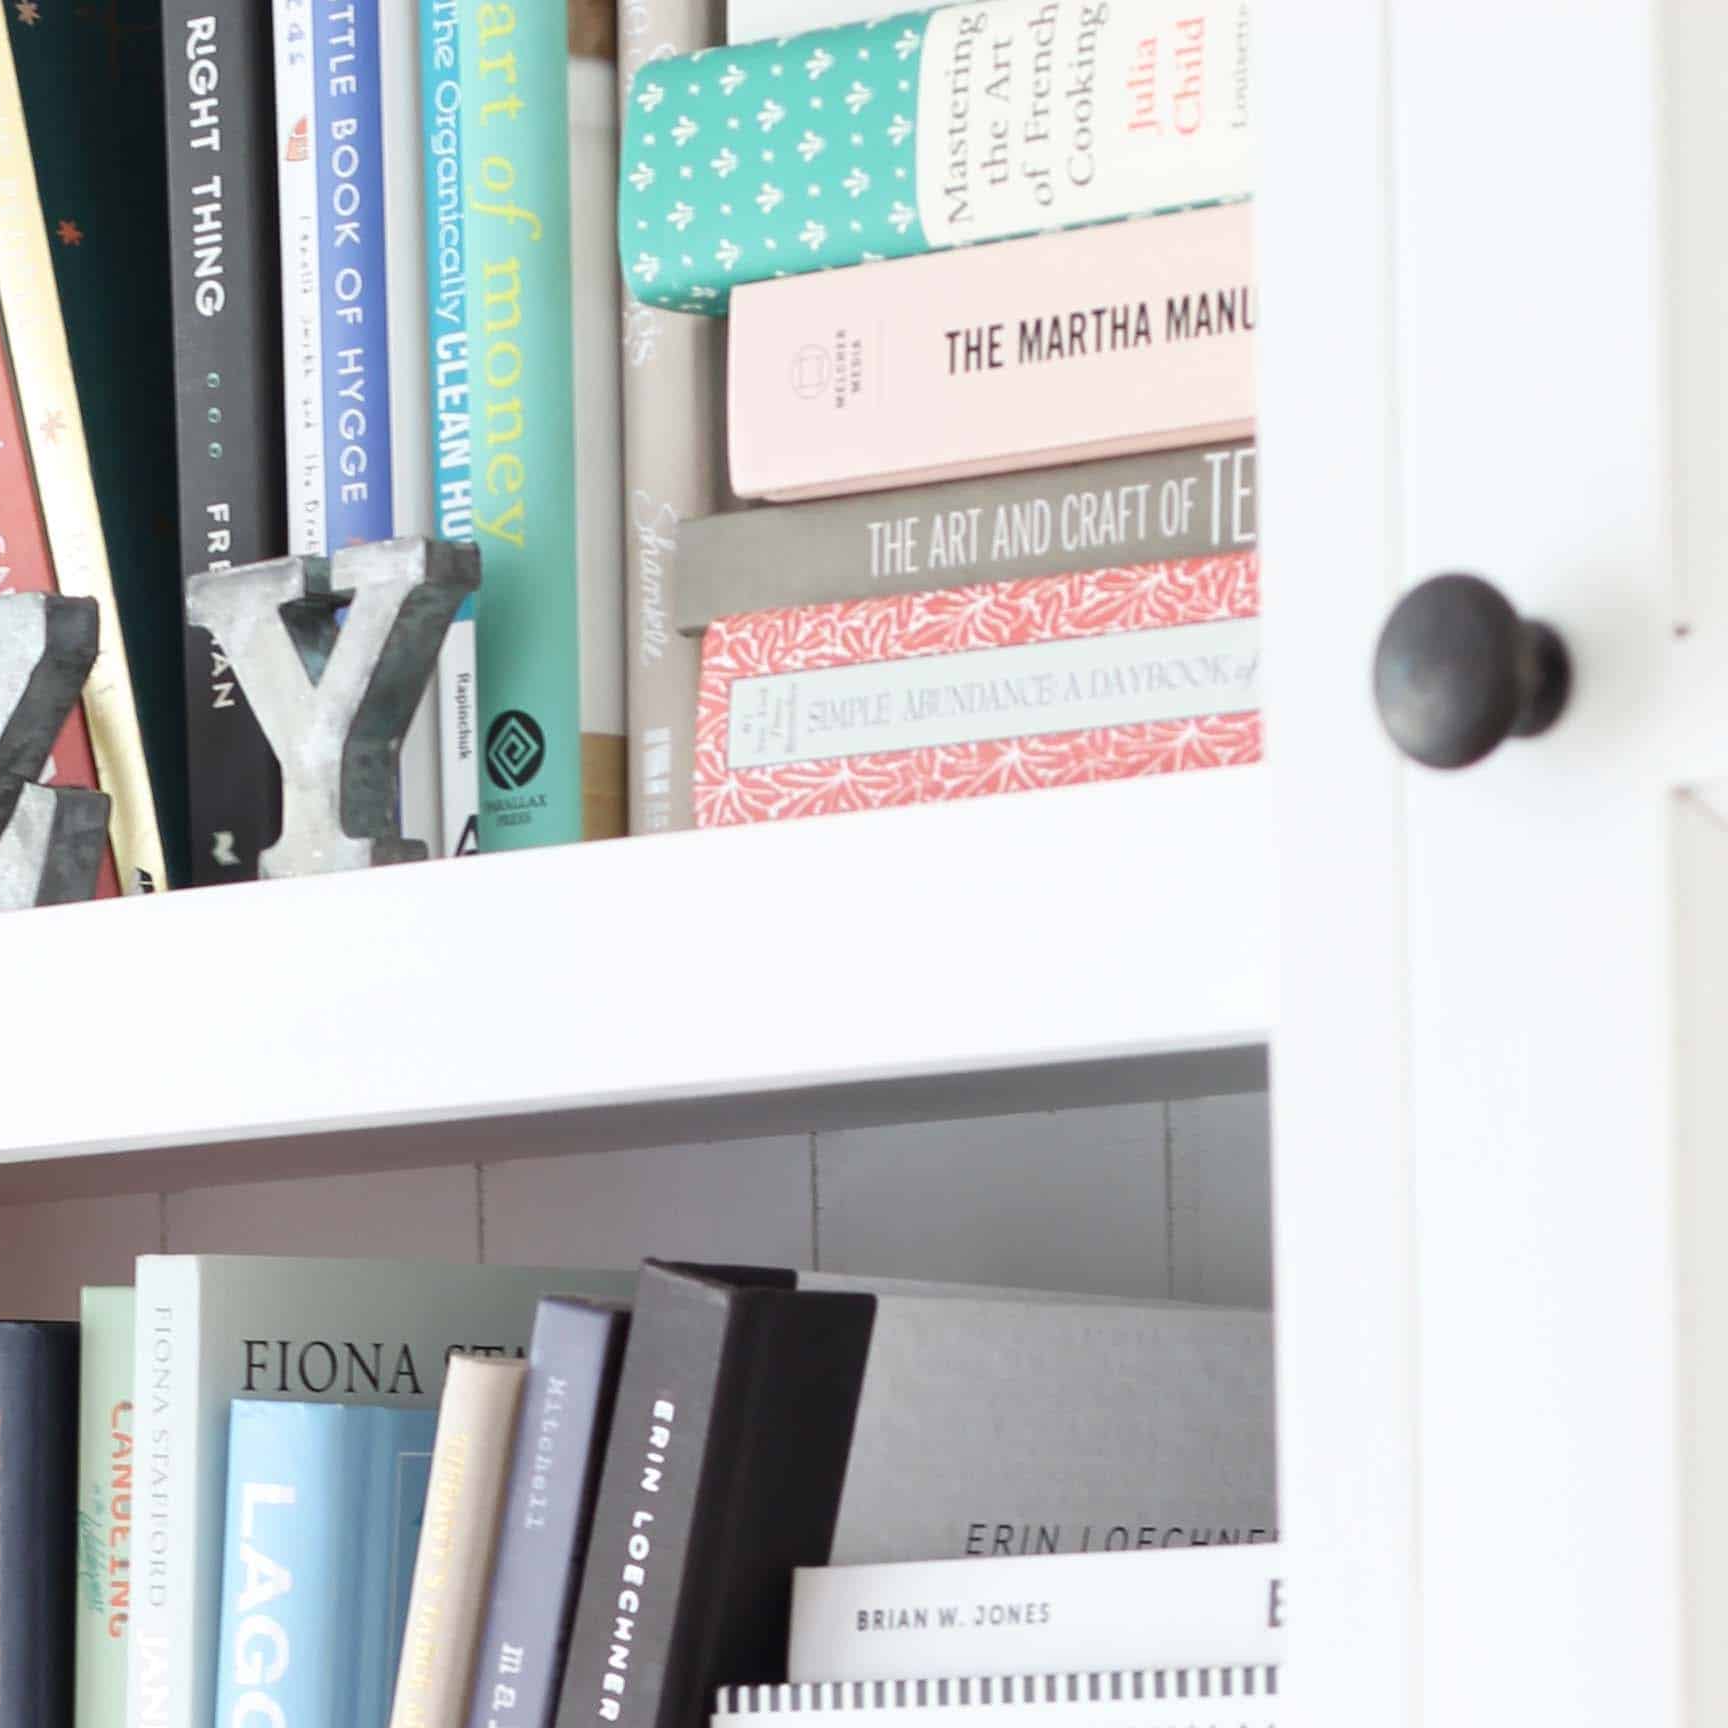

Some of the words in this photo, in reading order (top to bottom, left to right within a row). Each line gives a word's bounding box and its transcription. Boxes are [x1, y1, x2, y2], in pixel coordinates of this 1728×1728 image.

[186, 16, 220, 151] RIGHT
[477, 3, 525, 125] art
[948, 8, 988, 224] Mastering
[985, 34, 1014, 102] Art
[1023, 2, 1060, 146] French
[1067, 0, 1109, 187] Cooking
[1127, 35, 1164, 136] Julia
[1175, 16, 1204, 137] Child
[331, 118, 361, 248] BOOK
[431, 80, 469, 323] Organically
[465, 155, 542, 243] of
[982, 115, 1009, 187] the
[1023, 157, 1051, 207] of
[192, 176, 225, 316] THING
[335, 268, 363, 327] OF
[945, 323, 1005, 376] THE
[1018, 301, 1151, 364] MARTHA
[337, 347, 367, 504] HYGGE
[436, 330, 472, 478] CLEAN
[474, 257, 526, 549] money
[868, 517, 919, 577] THE
[928, 507, 982, 569] ART
[991, 497, 1051, 561] AND
[1061, 484, 1153, 552] CRAFT
[1161, 478, 1196, 536] OF
[456, 673, 471, 759] Rapinchuk
[808, 691, 891, 733] SIMPLE
[902, 676, 1053, 724] ABUNDANCE
[1091, 656, 1231, 698] DAYBOOK
[152, 1304, 173, 1416] FIONA
[241, 1339, 424, 1395] FIONA
[525, 1377, 568, 1530] Mitchell
[640, 1400, 675, 1493] ERIN
[149, 1428, 170, 1609] STAFFORD
[598, 1511, 653, 1721] LOECHNER
[857, 1609, 928, 1632] BRIAN
[938, 1607, 964, 1629] W.
[975, 1603, 1052, 1626] JONES
